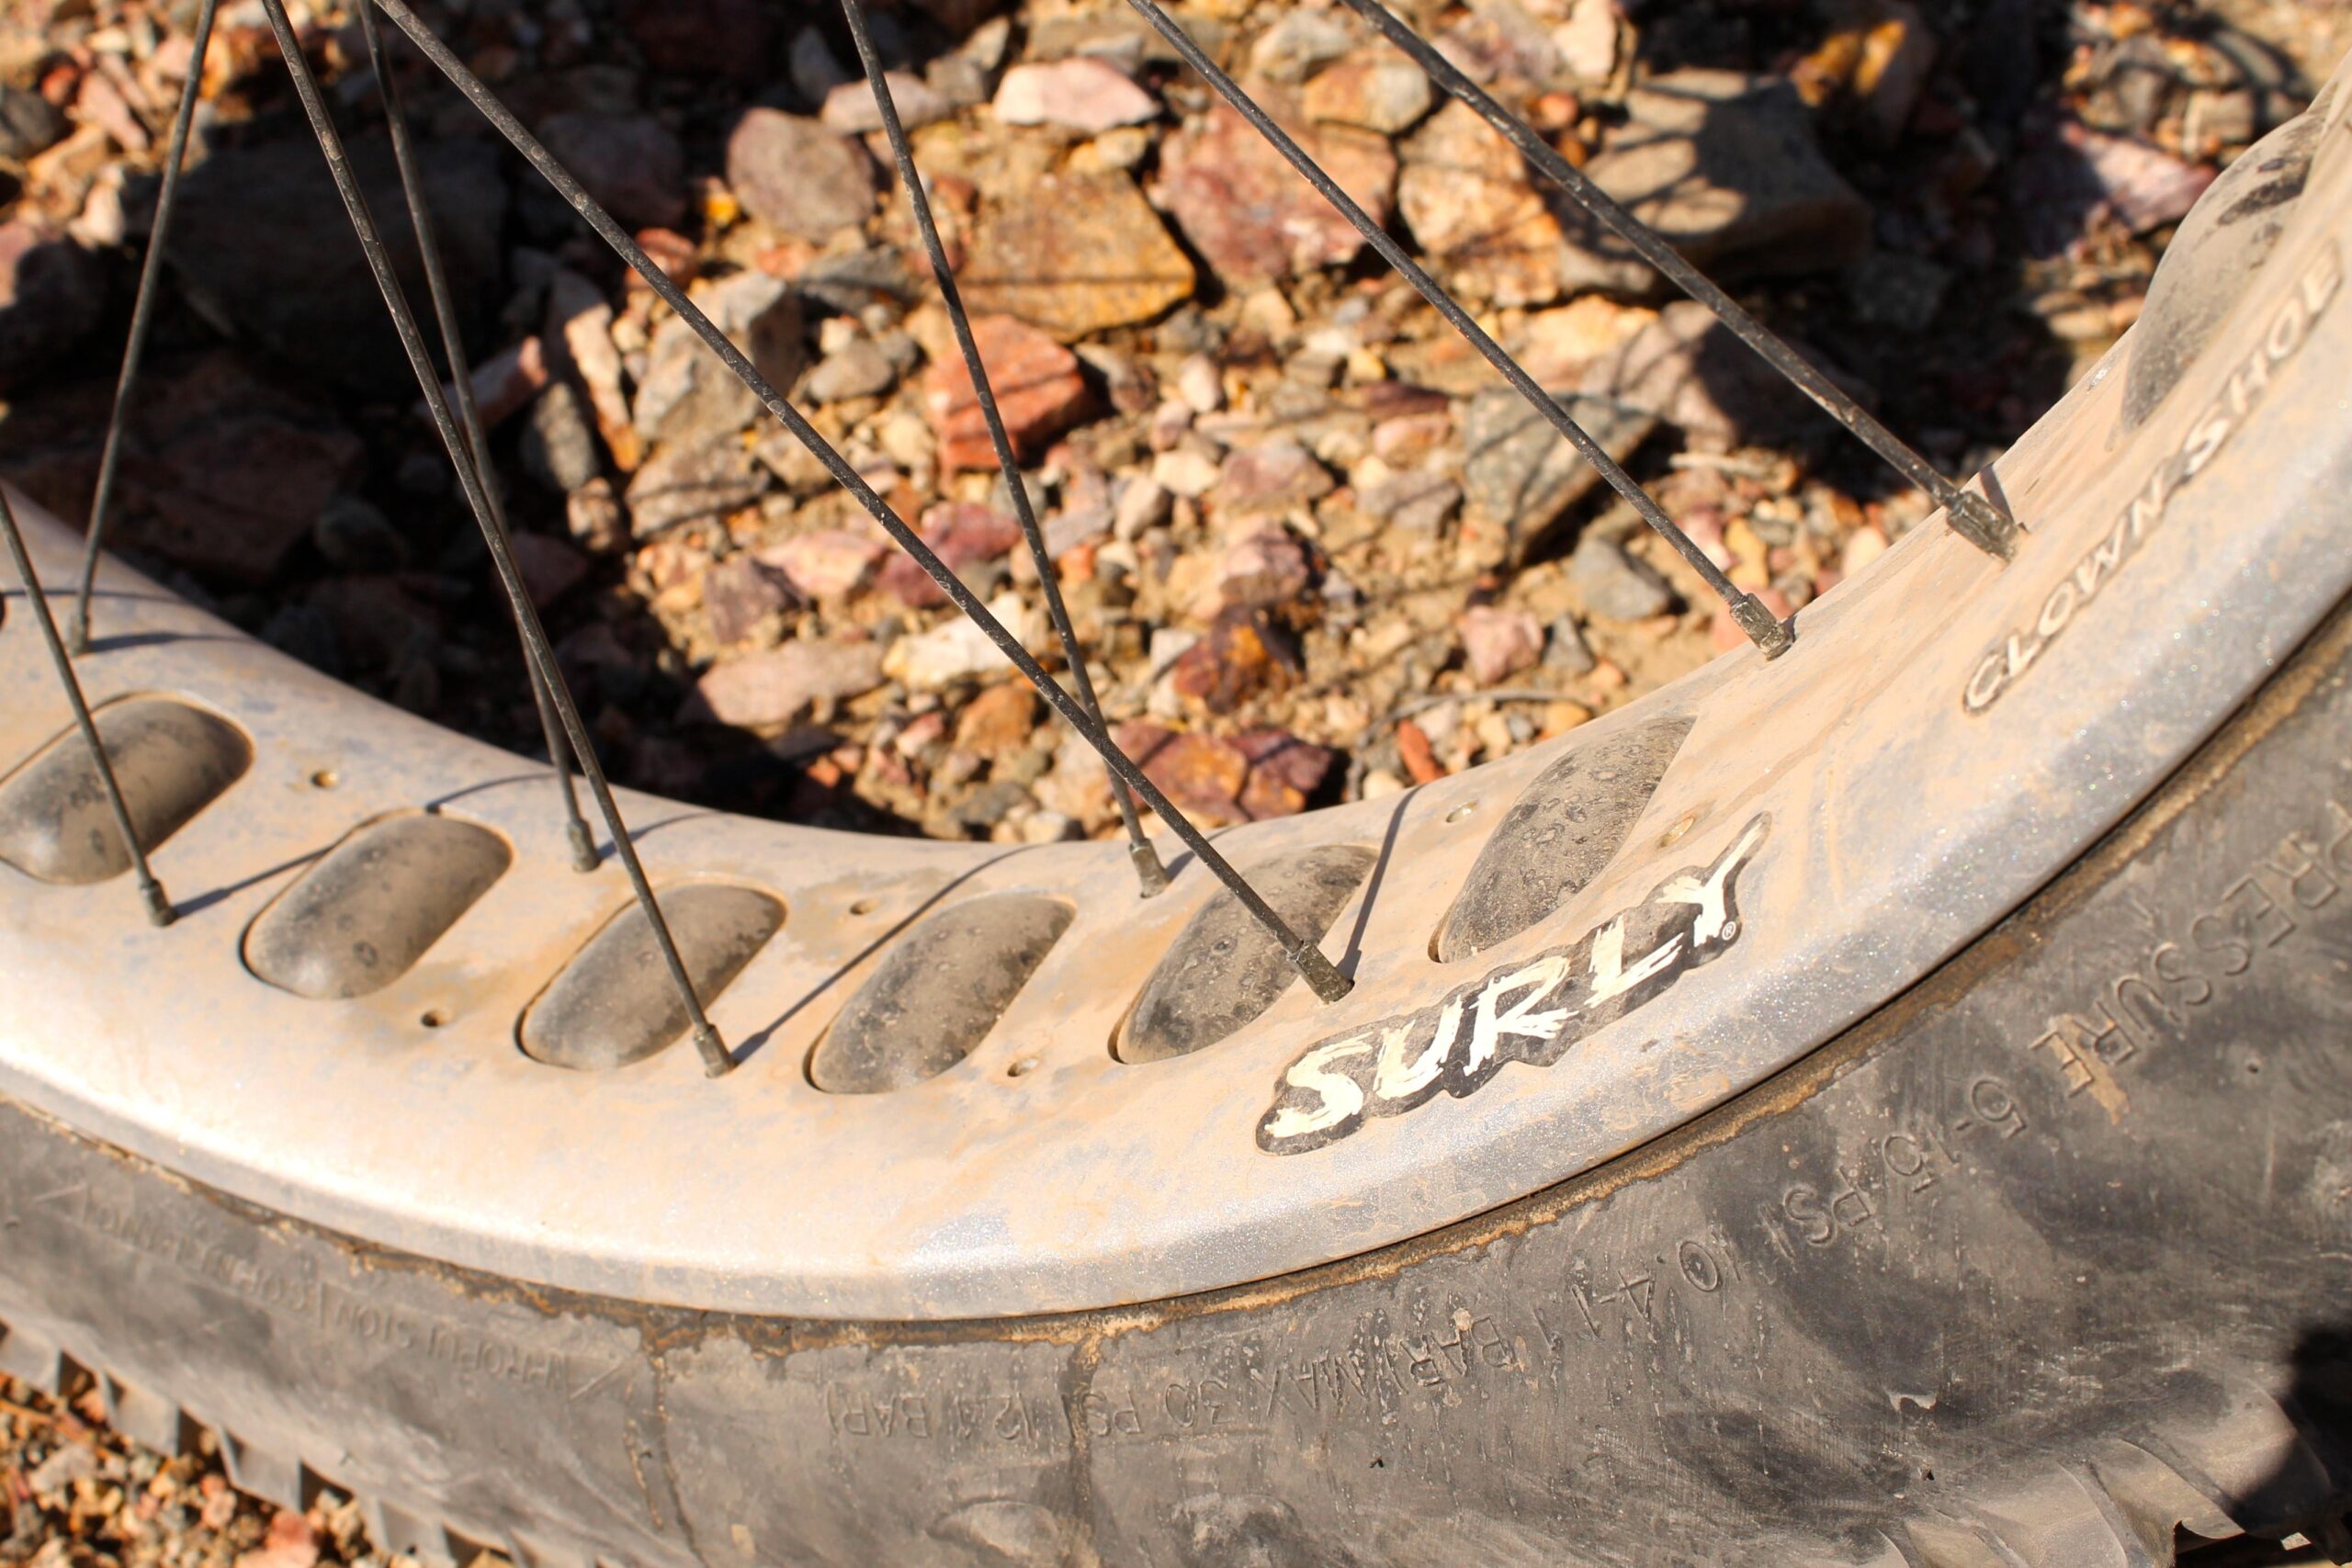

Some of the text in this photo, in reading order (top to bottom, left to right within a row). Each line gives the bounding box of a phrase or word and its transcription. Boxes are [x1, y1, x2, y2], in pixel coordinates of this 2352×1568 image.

[1964, 237, 2342, 711] CLOWN SHOE
[1883, 1077, 2027, 1194] 5-15
[1758, 1166, 1871, 1258] PSI
[1060, 1385, 1145, 1438] PSI
[1164, 1378, 1228, 1429] 30
[1250, 1350, 1368, 1418] MAX
